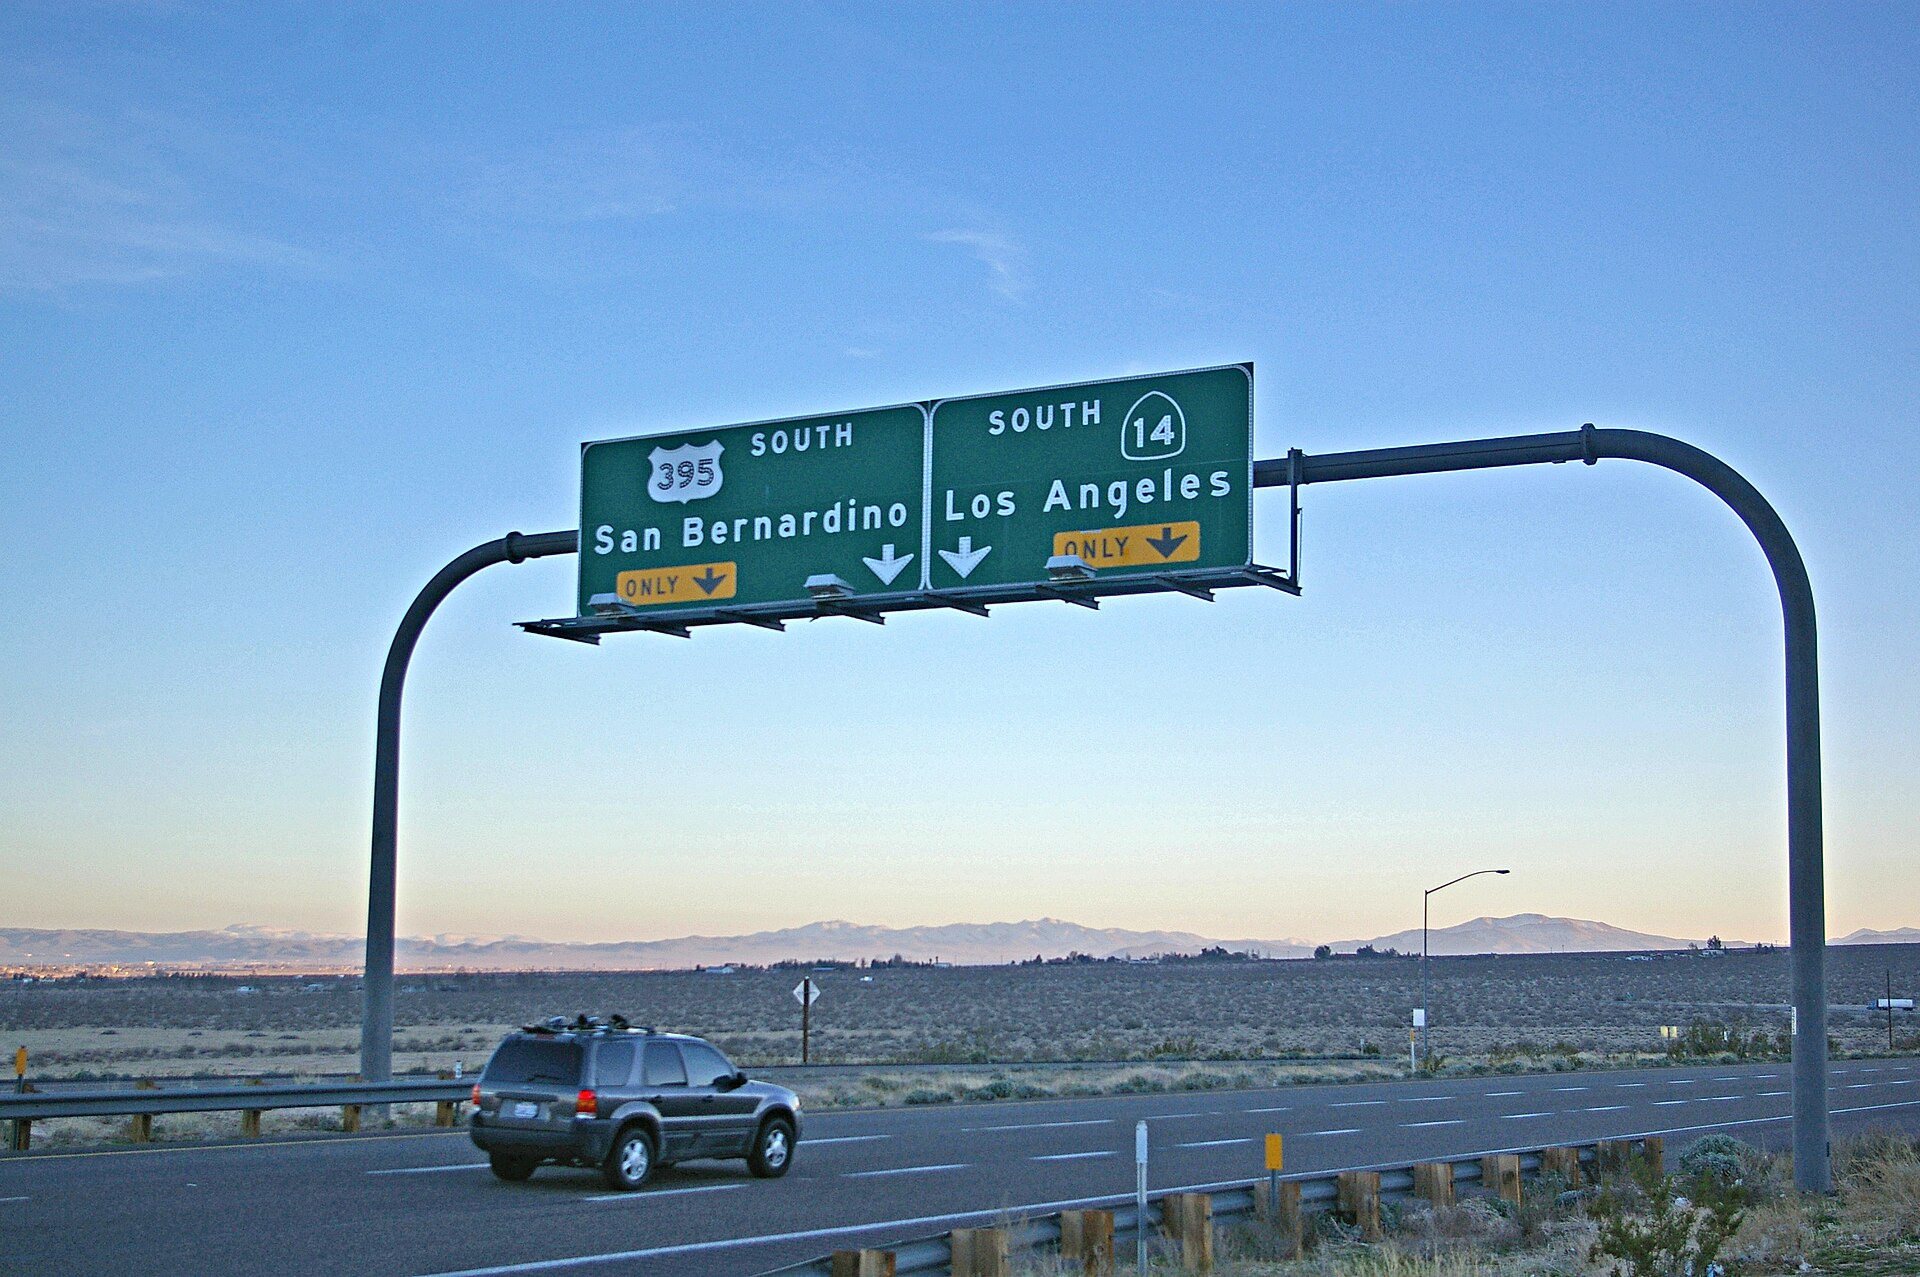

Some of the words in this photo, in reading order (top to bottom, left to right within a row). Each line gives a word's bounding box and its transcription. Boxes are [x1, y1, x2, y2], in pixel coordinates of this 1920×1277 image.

[988, 399, 1101, 436] SOUTH
[1133, 414, 1175, 448] 14
[750, 422, 852, 457] SOUTH
[657, 458, 715, 491] 395
[945, 489, 1016, 521] Los
[1043, 468, 1231, 519] Angeles
[594, 524, 661, 555] San
[682, 498, 907, 548] Bernardino
[1064, 536, 1129, 560] ONLY
[625, 575, 679, 597] ONLY
